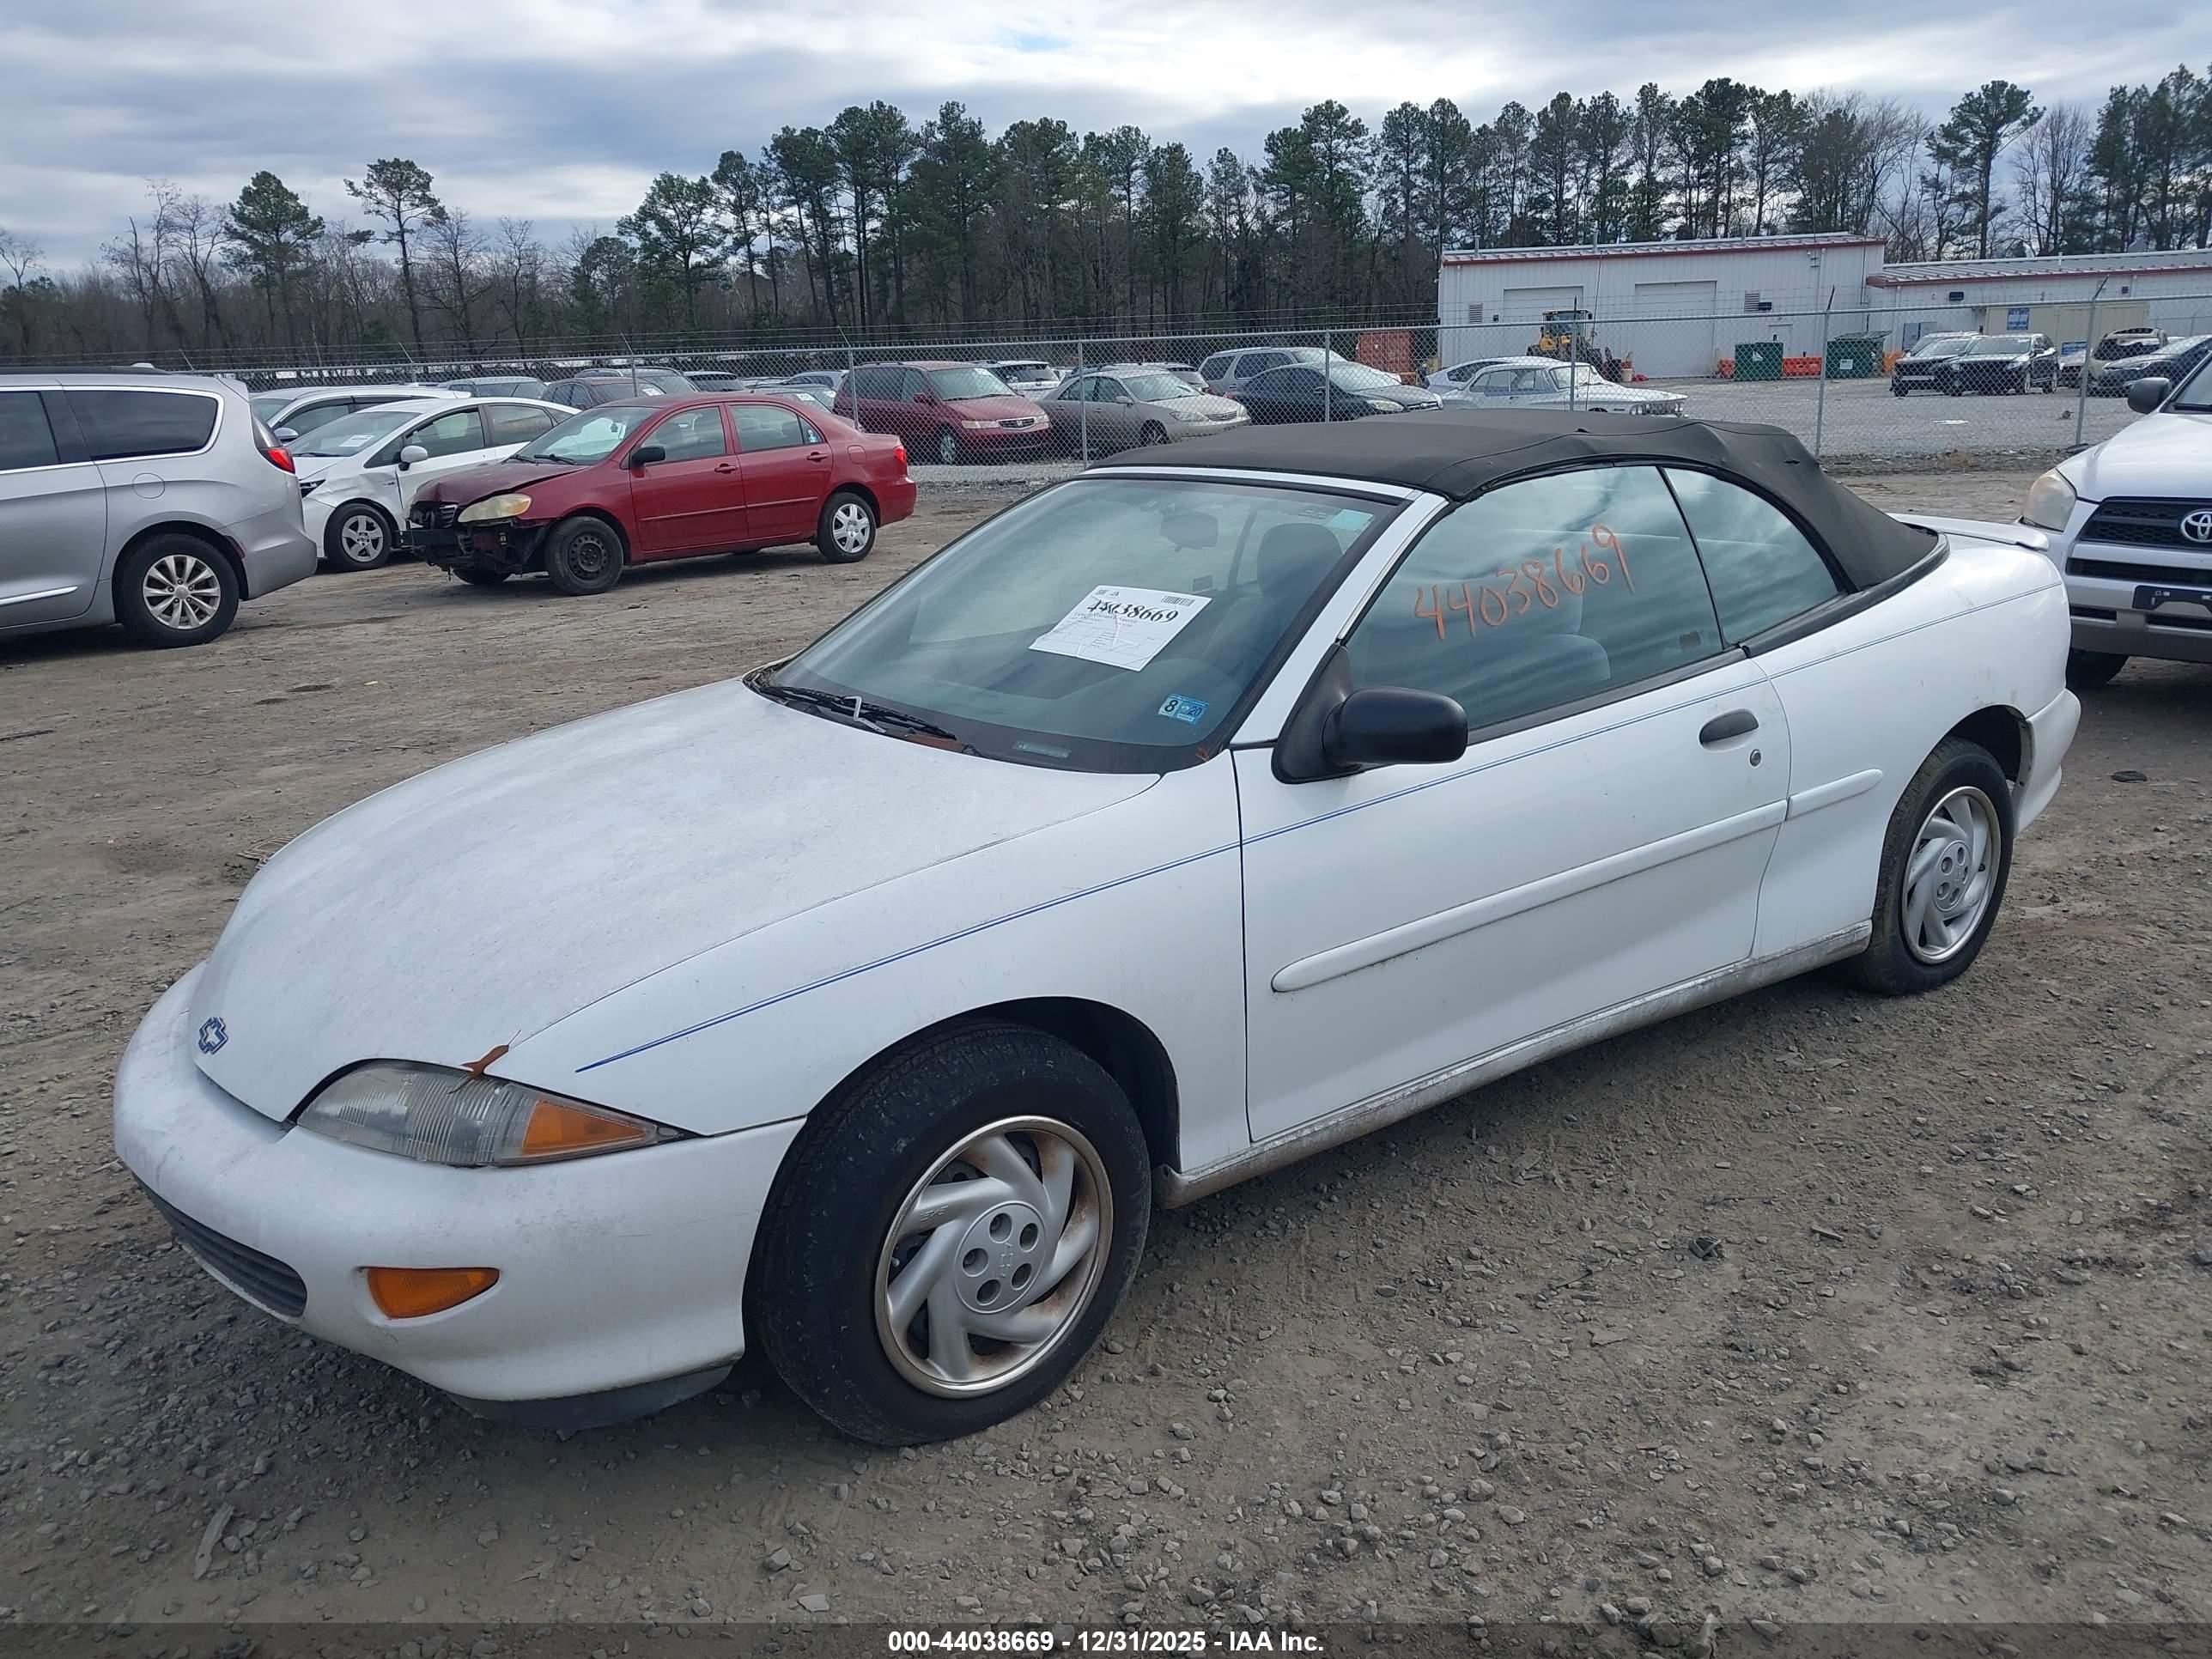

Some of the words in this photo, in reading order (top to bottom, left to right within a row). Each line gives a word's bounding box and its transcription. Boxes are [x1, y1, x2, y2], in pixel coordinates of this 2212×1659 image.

[1414, 525, 1635, 640] 44038669
[1087, 599, 1179, 623] 44038669
[1164, 700, 1178, 712] 8
